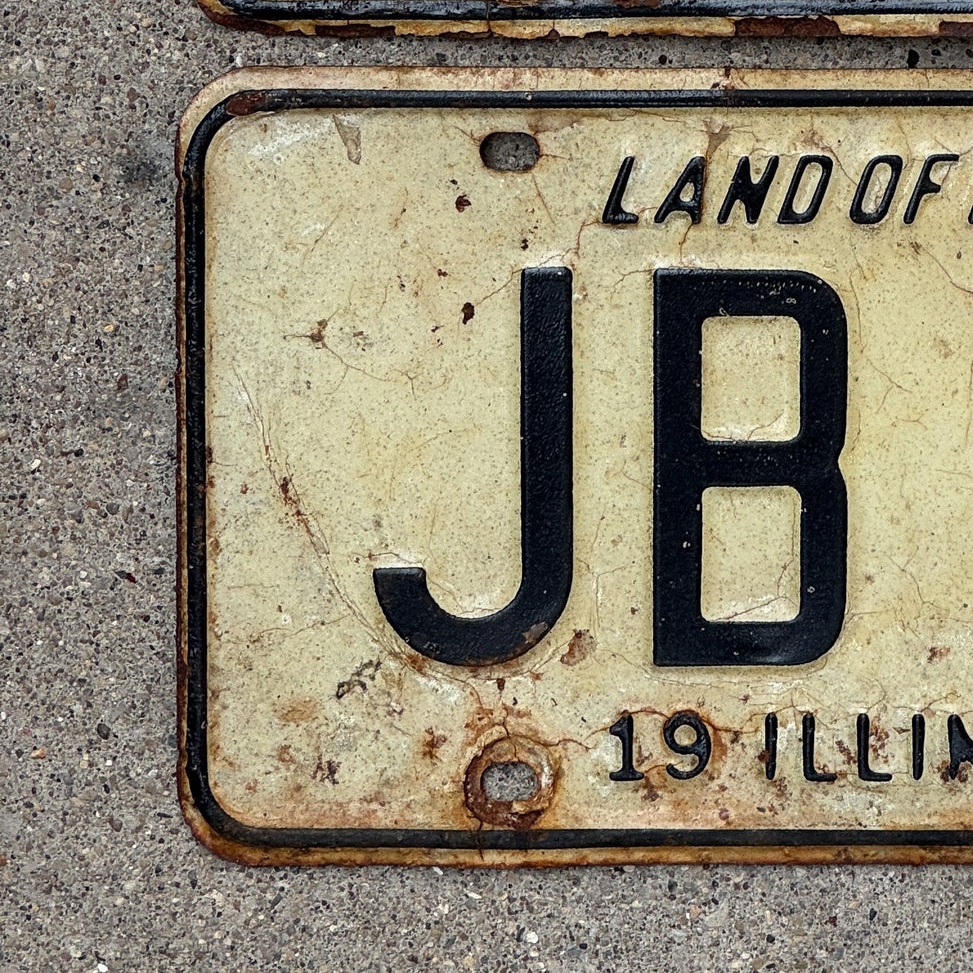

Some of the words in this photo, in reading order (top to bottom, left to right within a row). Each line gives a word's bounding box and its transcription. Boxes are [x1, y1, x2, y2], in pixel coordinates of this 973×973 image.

[600, 154, 834, 225] LAND
[849, 153, 960, 225] OF
[373, 267, 849, 668] JB
[608, 709, 713, 782] 19
